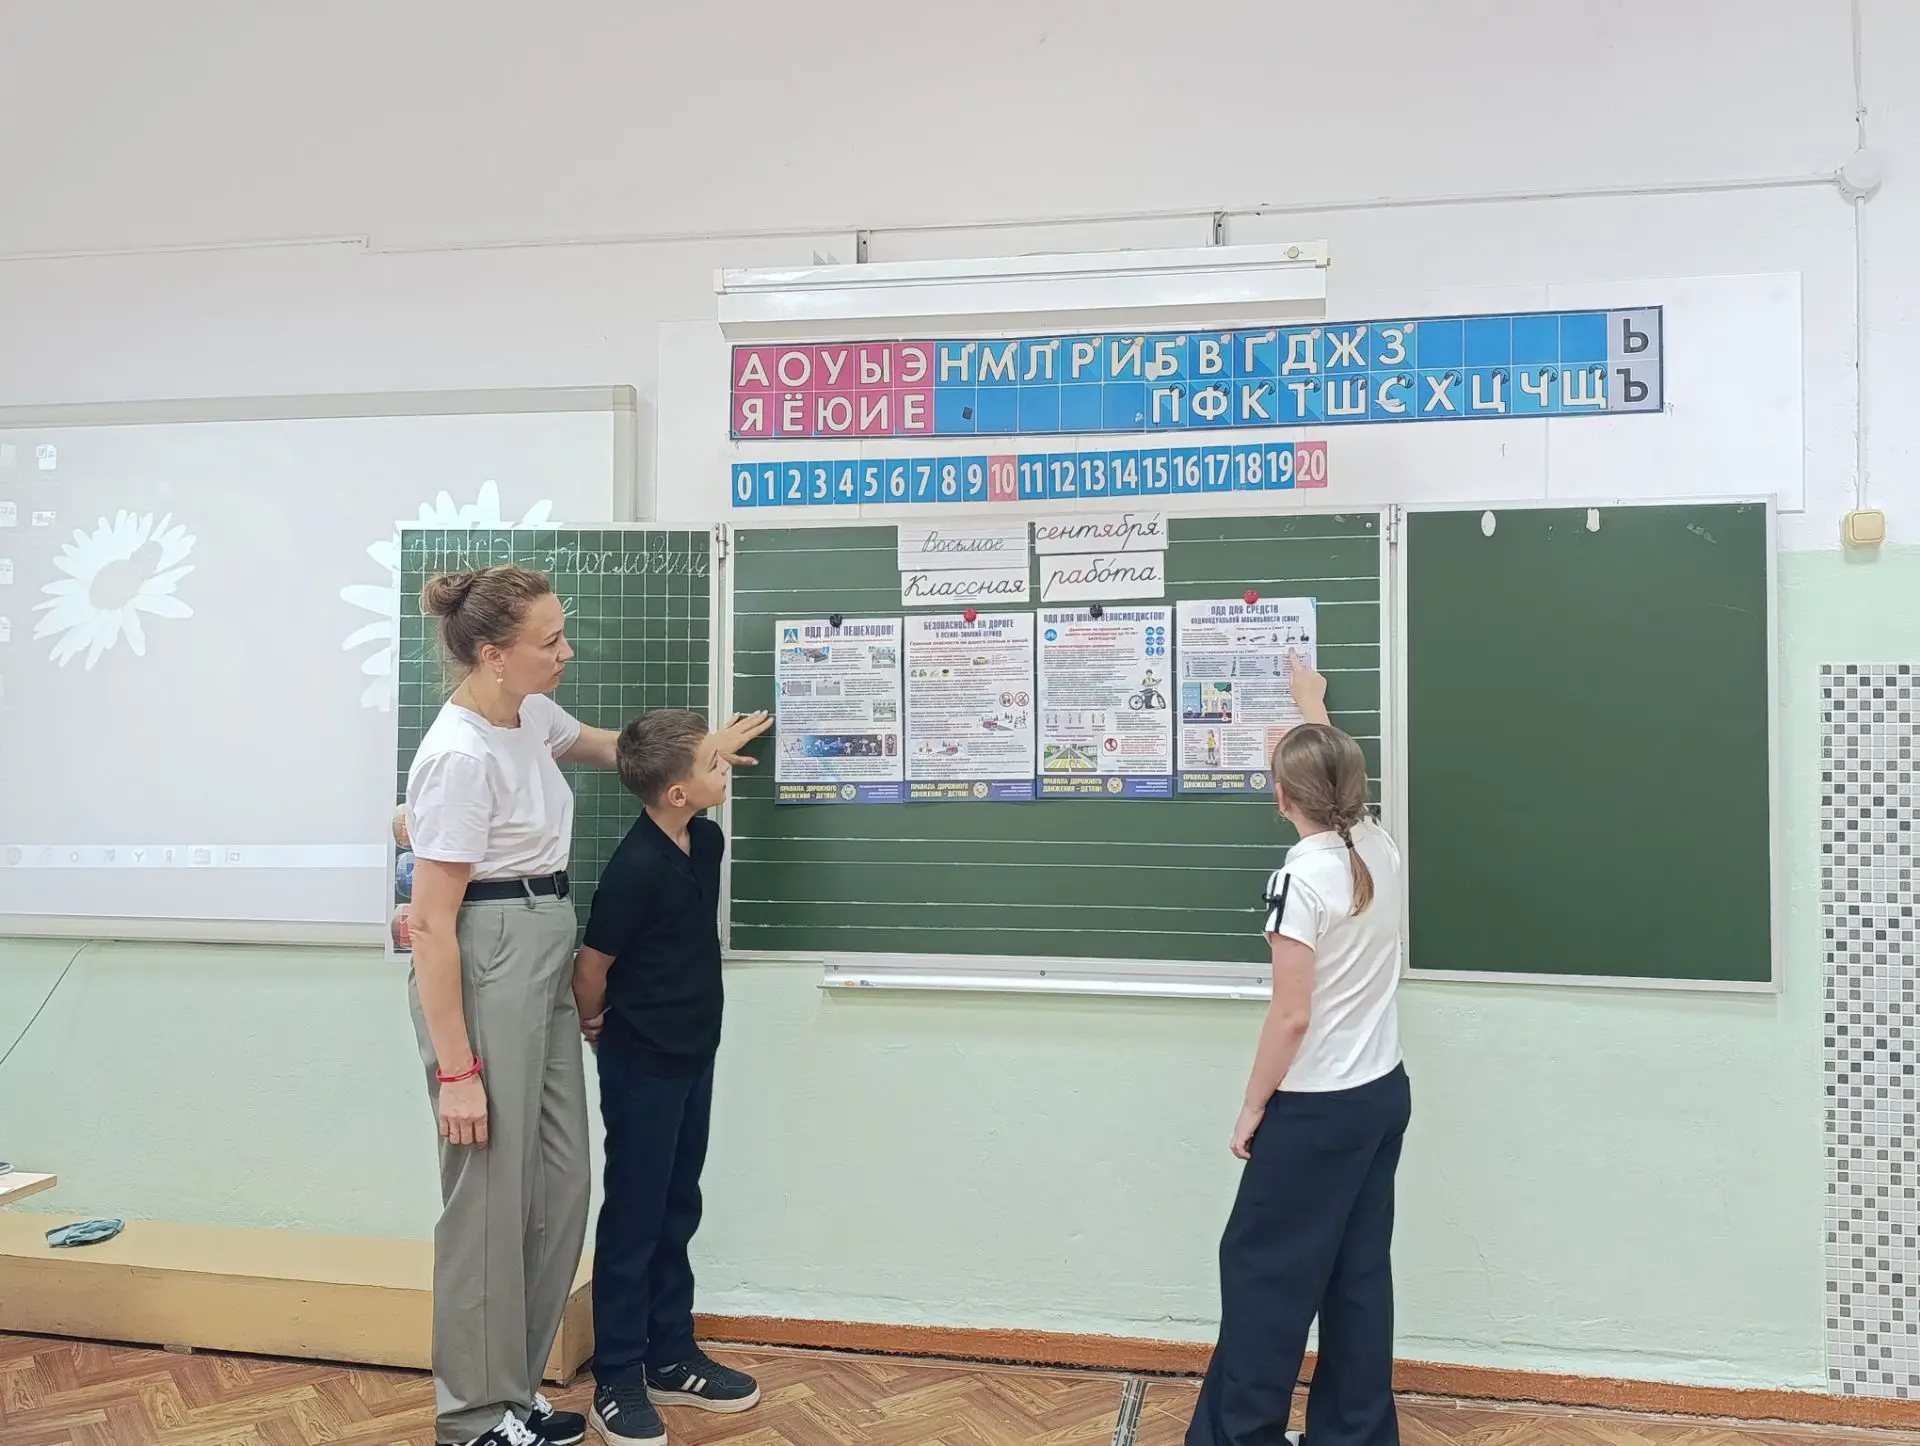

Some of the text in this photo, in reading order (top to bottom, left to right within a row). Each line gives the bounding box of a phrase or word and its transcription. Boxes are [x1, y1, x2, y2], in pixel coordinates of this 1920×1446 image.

[737, 318, 1650, 387] А О У Ы Э Н М Л Р Й Б В Г Д Ж З Ь
[740, 368, 1649, 432] Я Ё Ю И Е П Ф К Т Ш С Х Ц Ч Щ Ъ
[738, 449, 1325, 500] 0 1 2 3 4 5 6 7 8 9 10 11 12 13 14 15 16 17 18 19 20
[904, 574, 1026, 598] Классная
[923, 619, 1015, 630] БЕЗОПАСНОСТЬ НА ДОРОГЕ
[1210, 604, 1279, 616] ПДД ДЛЯ СРЕДСТВ
